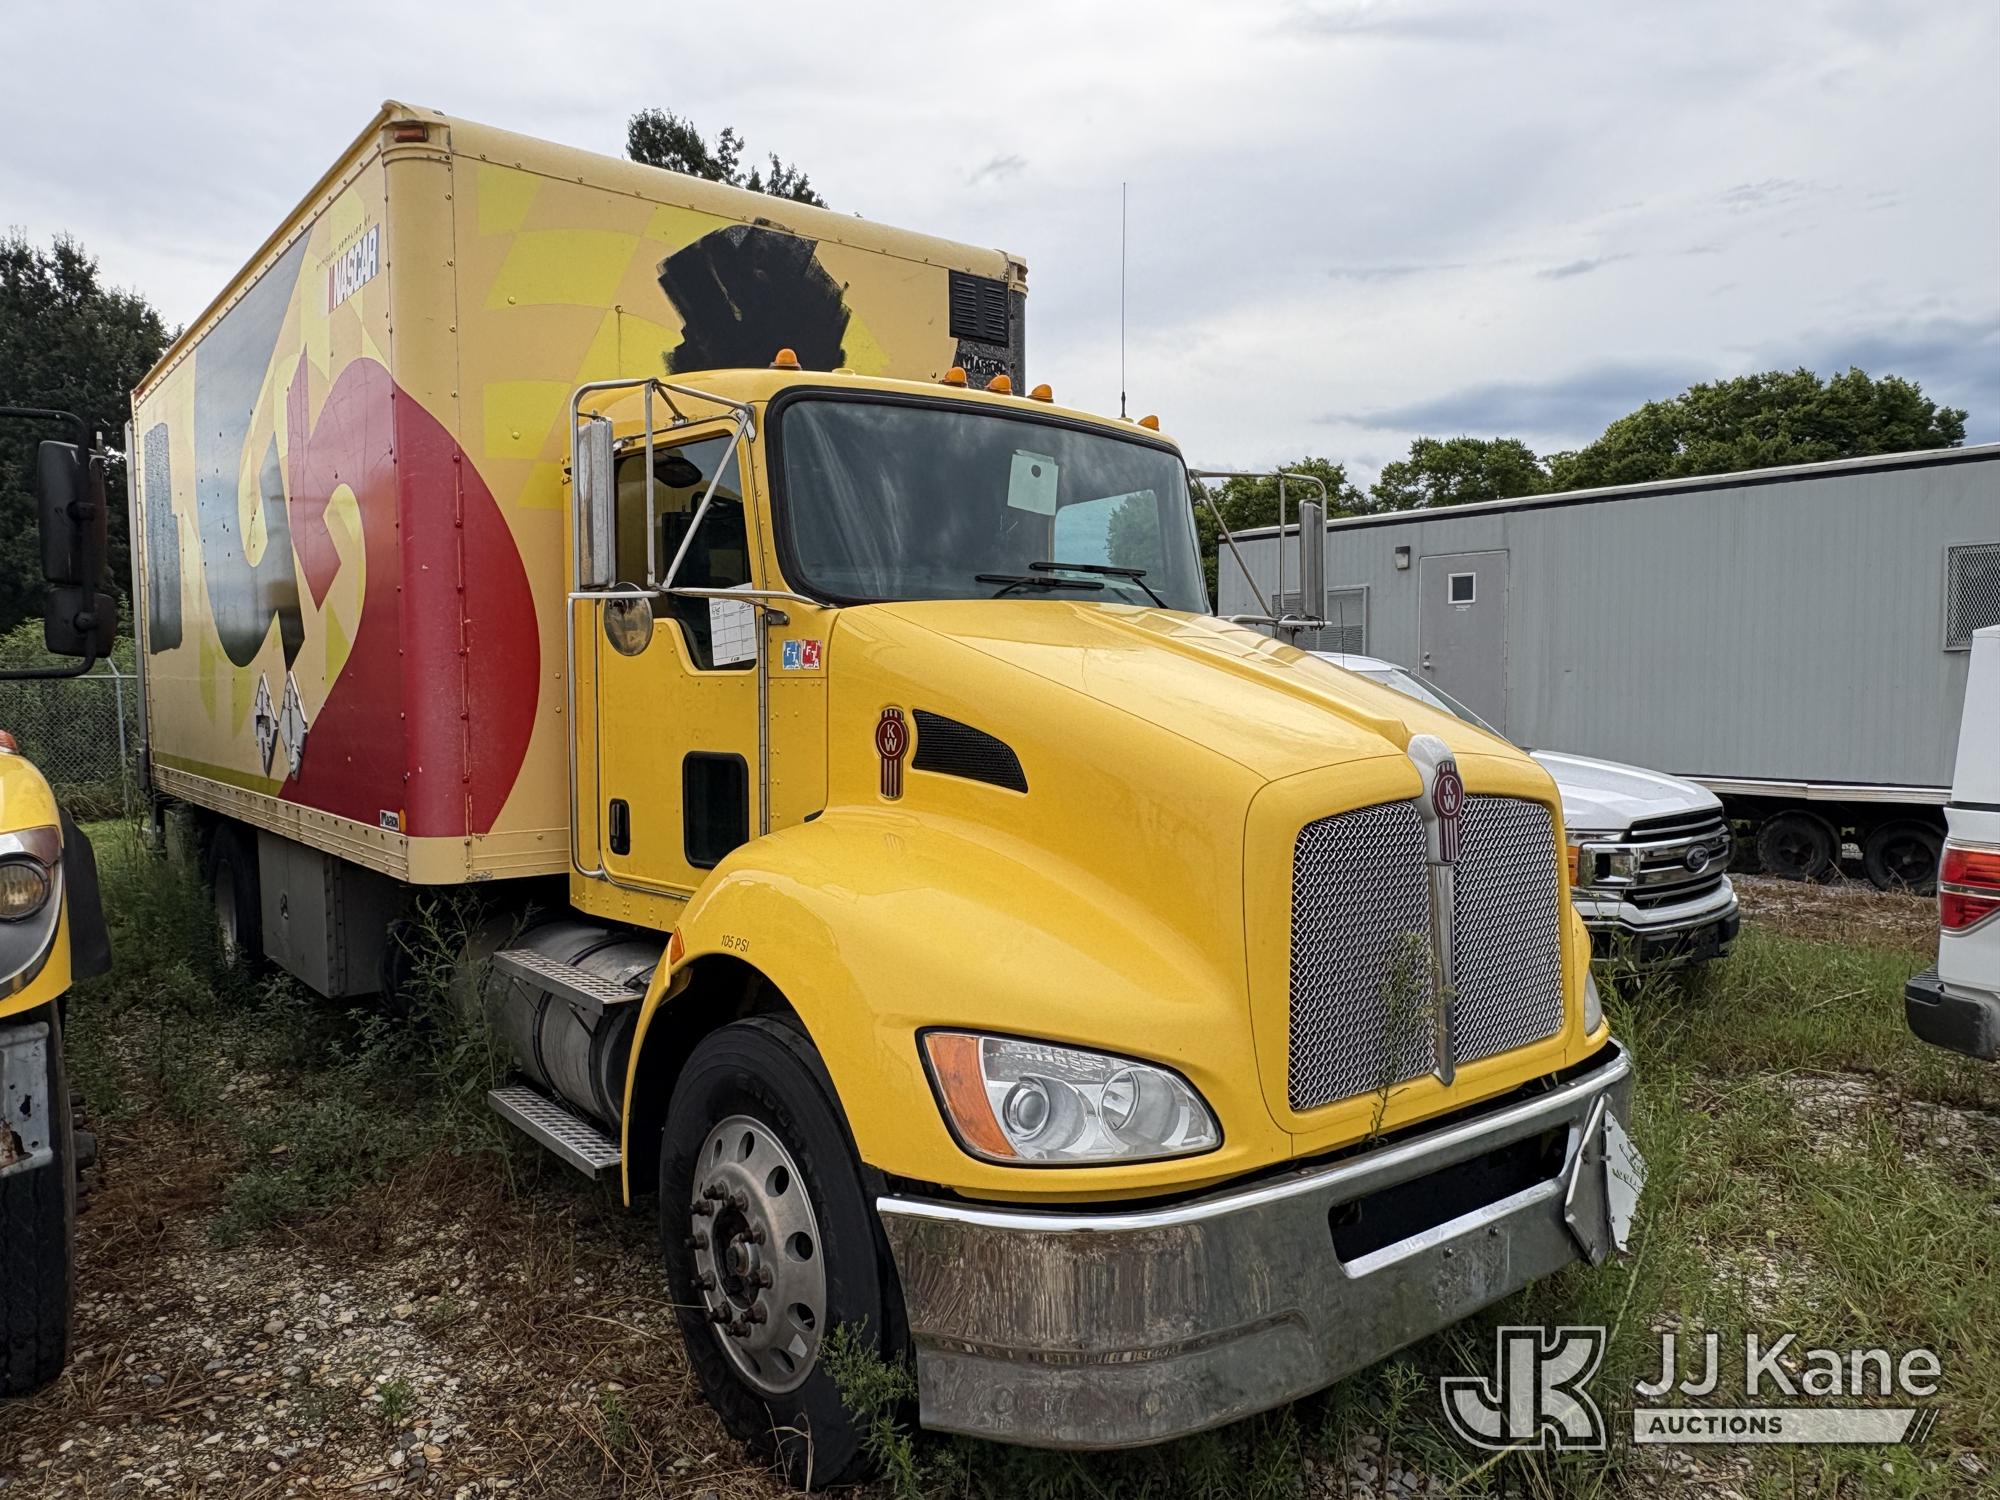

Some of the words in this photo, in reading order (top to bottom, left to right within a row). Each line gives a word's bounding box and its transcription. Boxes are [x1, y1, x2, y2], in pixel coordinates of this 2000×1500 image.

[331, 226, 378, 311] NASCAR
[721, 934, 735, 948] 105
[735, 937, 750, 952] PSI
